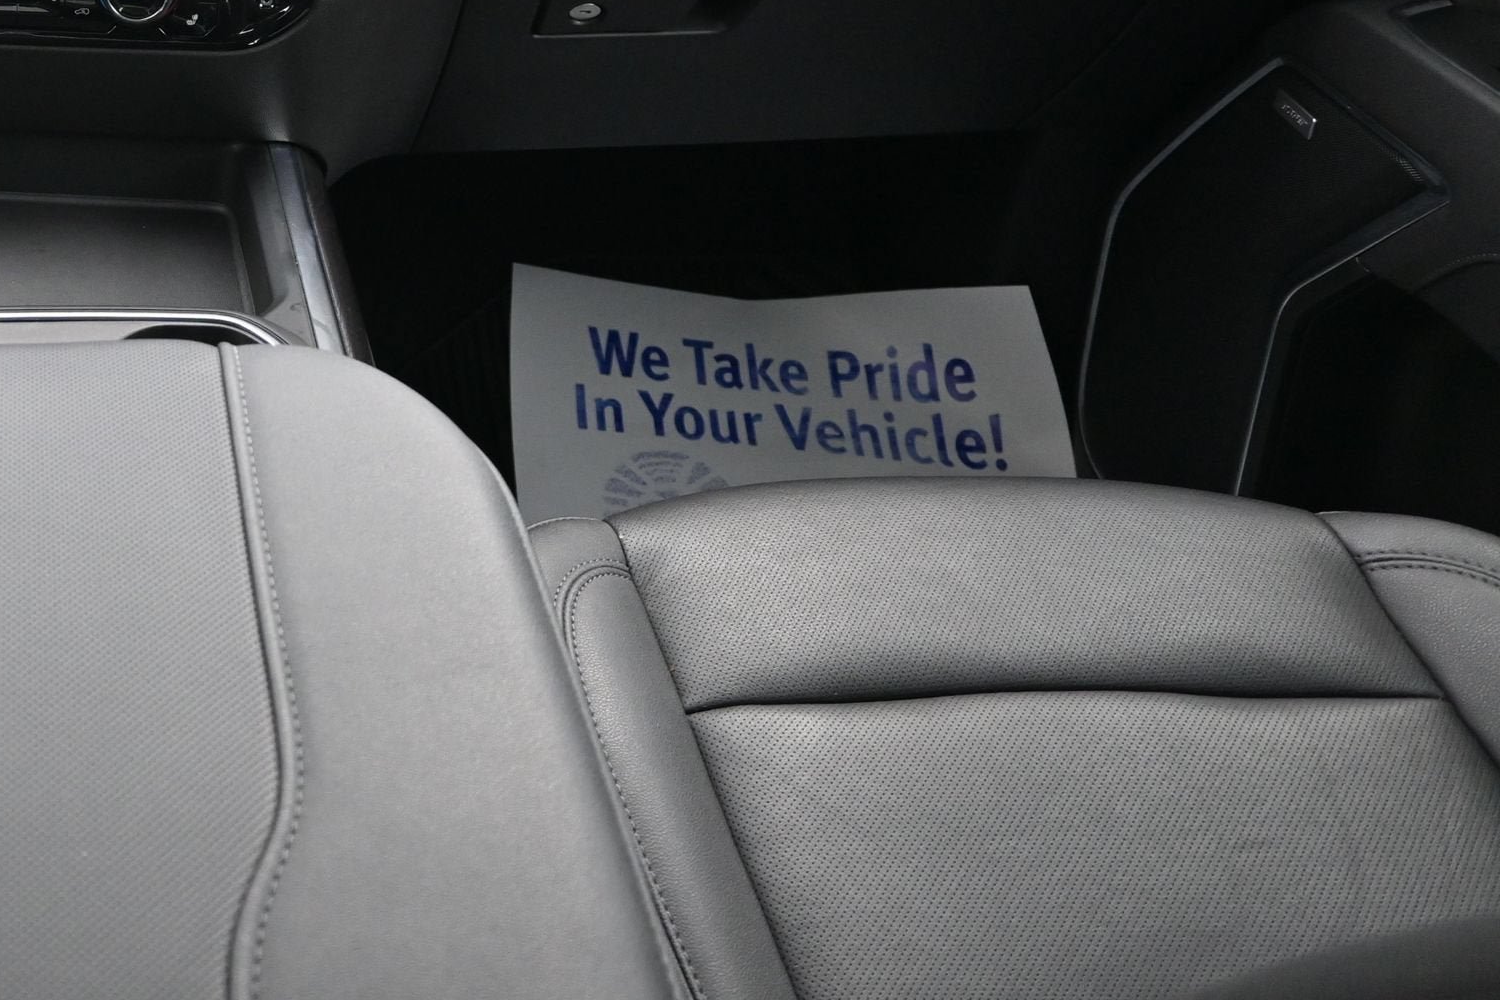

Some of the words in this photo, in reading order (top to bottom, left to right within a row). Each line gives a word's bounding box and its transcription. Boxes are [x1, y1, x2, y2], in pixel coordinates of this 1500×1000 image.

[587, 326, 672, 383] We
[682, 337, 809, 396] Take
[827, 344, 977, 404] Pride
[573, 383, 626, 434] In
[637, 389, 765, 445] Your
[773, 403, 1008, 473] Vehicle!
